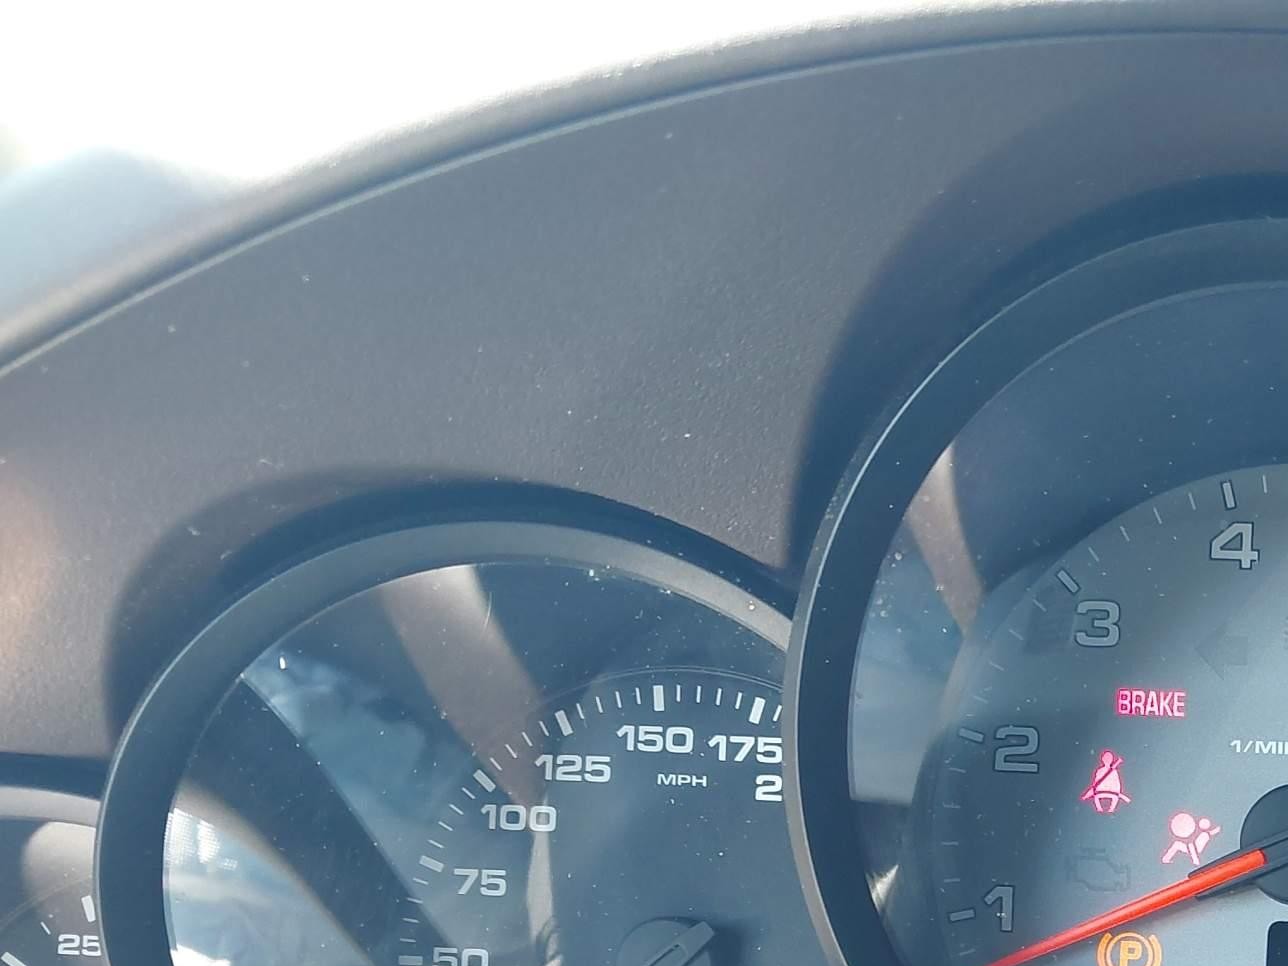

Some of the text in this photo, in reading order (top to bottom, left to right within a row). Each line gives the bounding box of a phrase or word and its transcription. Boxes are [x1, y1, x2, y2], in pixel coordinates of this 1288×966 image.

[1210, 521, 1260, 569] 4
[1074, 600, 1121, 647] 3
[1116, 688, 1187, 718] BRAKE
[616, 725, 694, 753] 150
[708, 735, 783, 764] 175
[993, 726, 1040, 773] 2
[535, 754, 612, 783] 125
[656, 773, 708, 787] MPH
[480, 803, 557, 832] 100
[453, 869, 507, 897] 75
[983, 884, 1016, 933] 1
